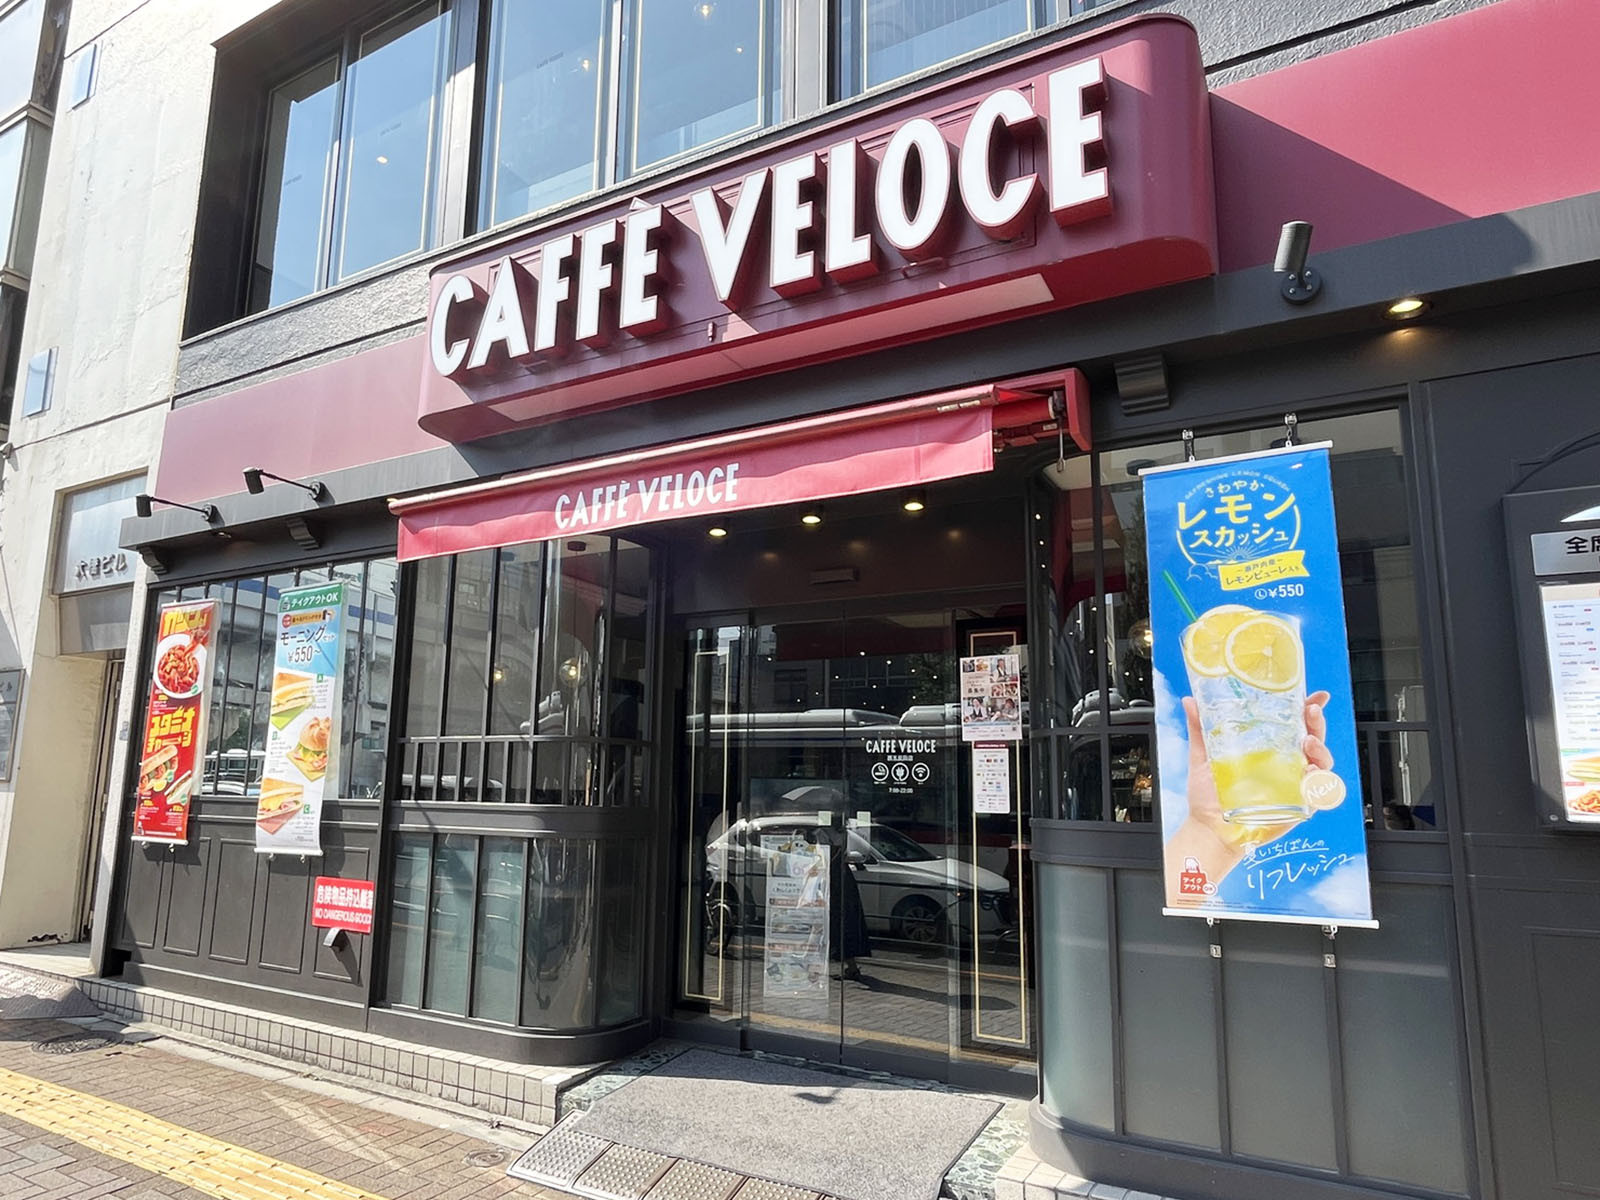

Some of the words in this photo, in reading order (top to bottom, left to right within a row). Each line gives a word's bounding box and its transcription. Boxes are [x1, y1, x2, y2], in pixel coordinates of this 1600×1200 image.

[431, 197, 662, 377] CAFFÈ
[691, 57, 1110, 304] VELOCE
[555, 480, 629, 529] CAFFÈ
[637, 463, 739, 514] VELOCE
[1204, 479, 1265, 498] さわやか
[1177, 492, 1296, 530] レモン
[1189, 523, 1290, 548] スカッシュ
[1268, 583, 1305, 598] ¥550
[898, 739, 937, 753] VELOCE
[1307, 778, 1339, 804] New
[1240, 838, 1325, 866] 夏いちばんの
[1247, 853, 1356, 900] リフレッシュ
